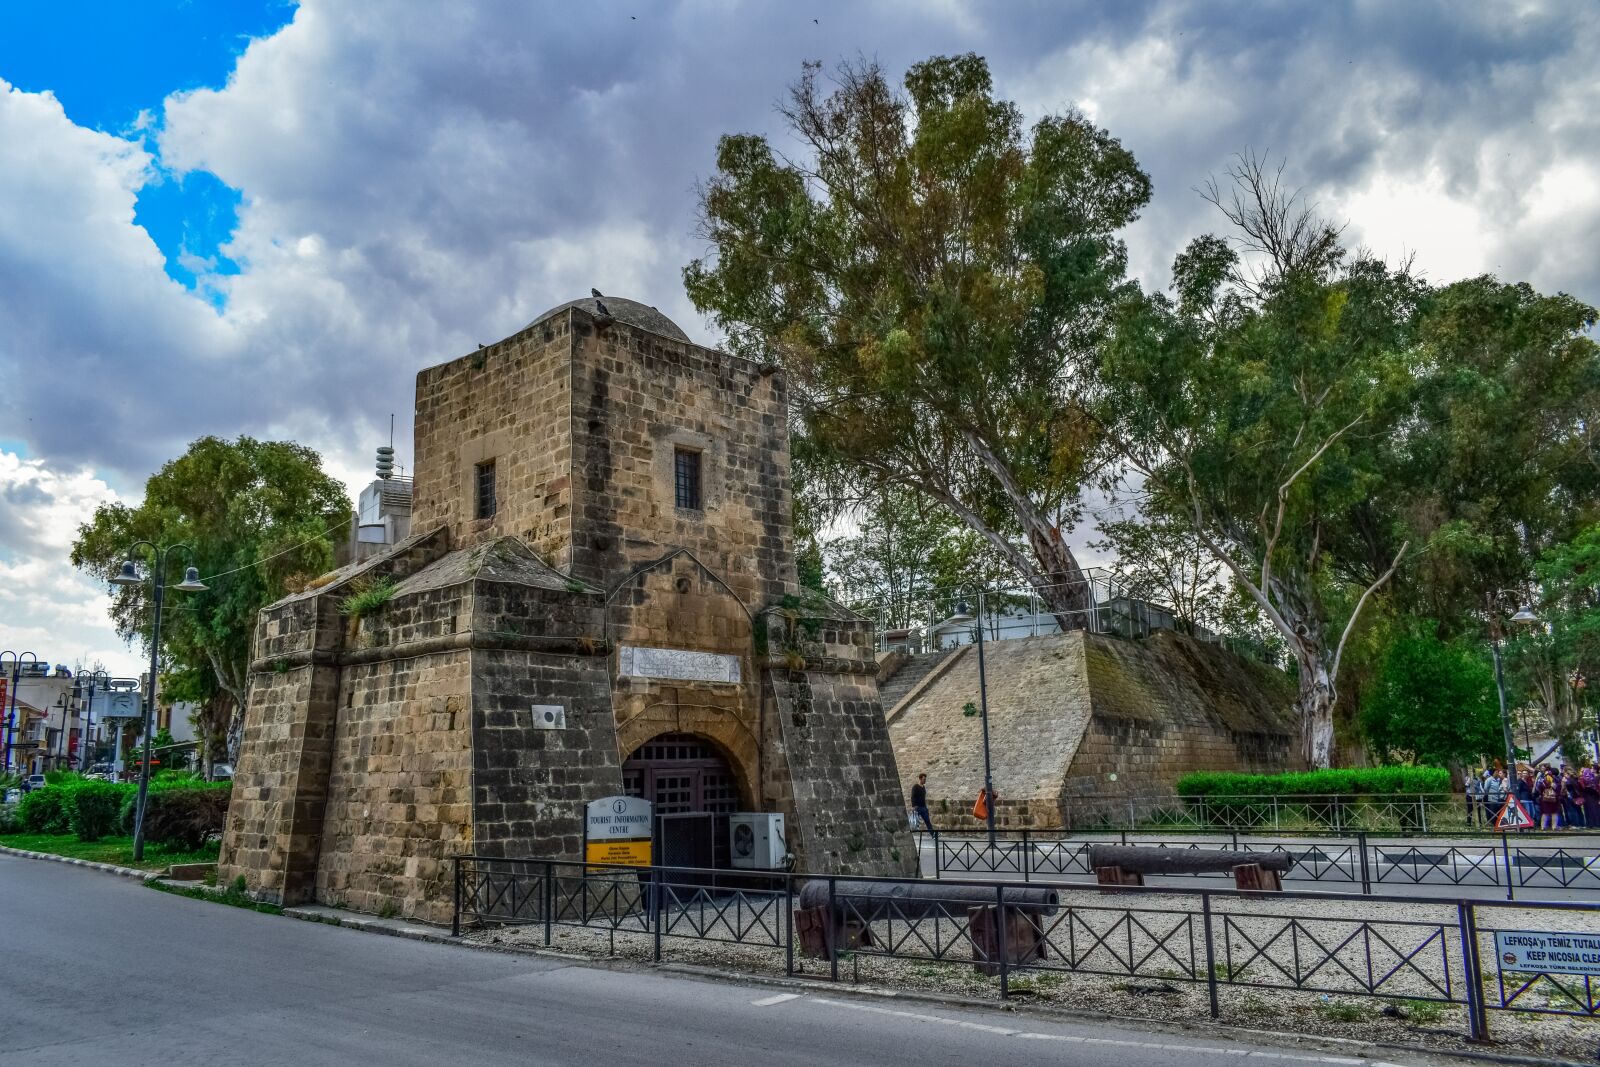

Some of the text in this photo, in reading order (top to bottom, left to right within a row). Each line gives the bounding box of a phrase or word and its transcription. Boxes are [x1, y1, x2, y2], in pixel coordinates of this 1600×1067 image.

[590, 815, 649, 824] TOURIST INFORMATION
[609, 826, 629, 834] CENTRE
[1547, 936, 1572, 948] TEMİZ
[1526, 950, 1546, 961] KEEP
[1548, 952, 1581, 962] NICOSIA
